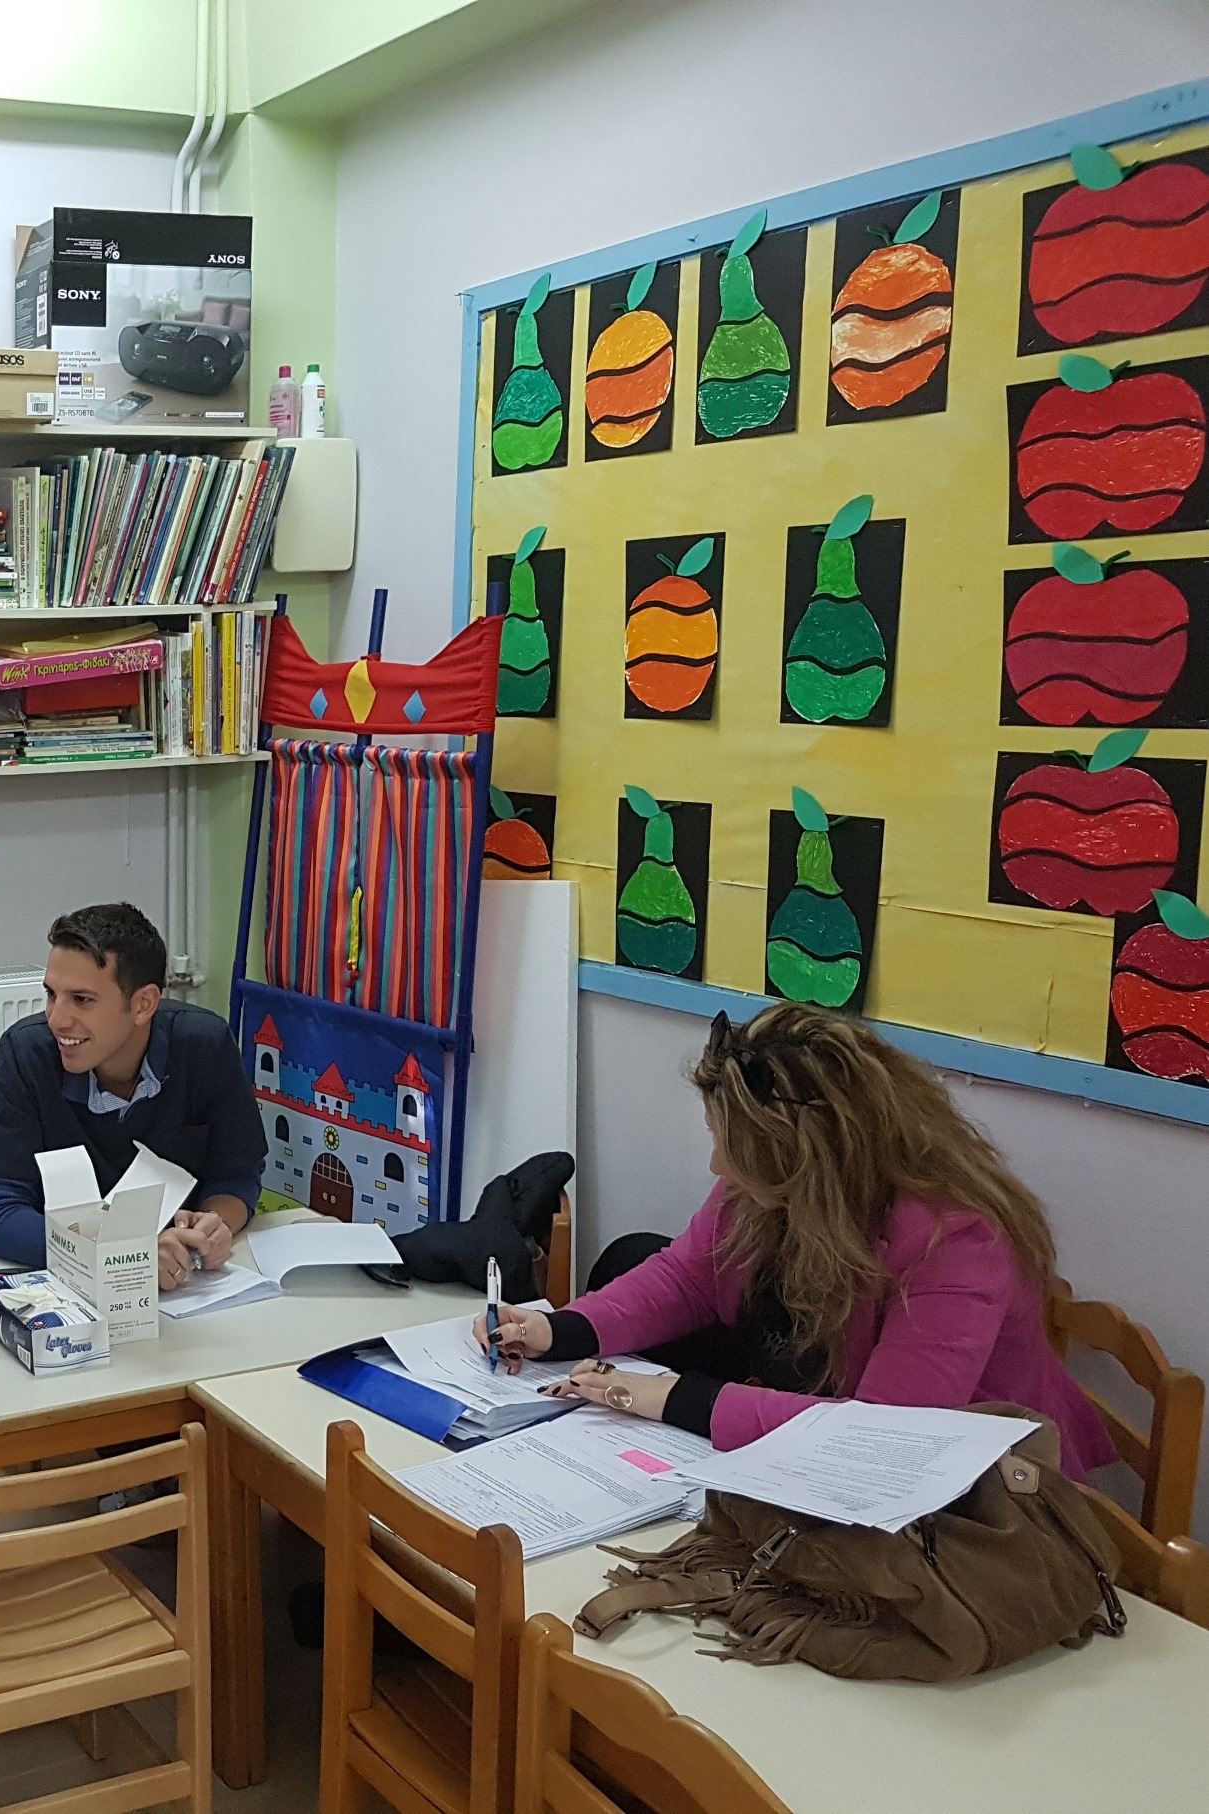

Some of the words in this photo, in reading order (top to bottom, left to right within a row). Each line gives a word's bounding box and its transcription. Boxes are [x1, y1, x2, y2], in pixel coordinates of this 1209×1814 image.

[208, 254, 246, 265] SONY
[57, 289, 101, 300] SONY
[51, 1229, 77, 1256] ANIMEX
[104, 1251, 150, 1266] ANIMEX
[109, 1303, 124, 1312] 250
[138, 1296, 150, 1308] CE
